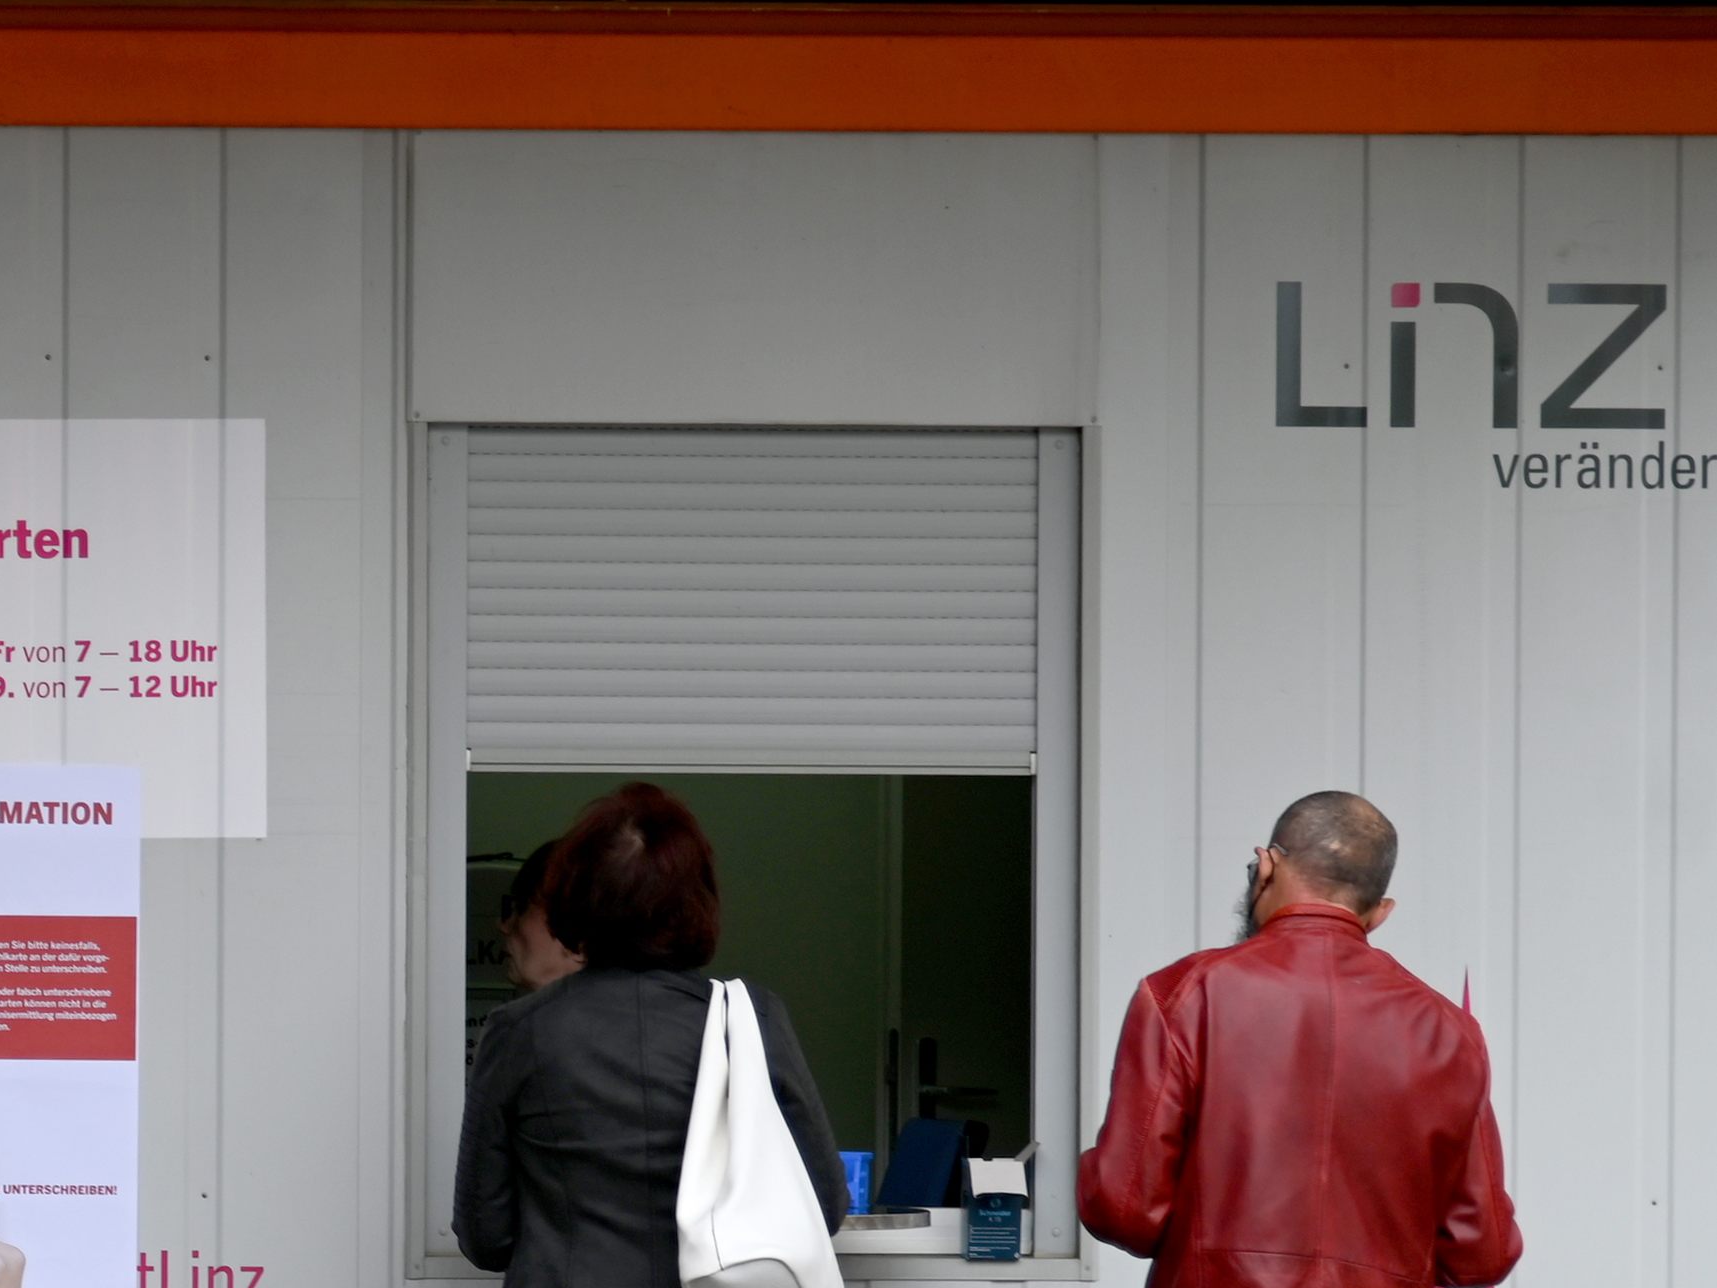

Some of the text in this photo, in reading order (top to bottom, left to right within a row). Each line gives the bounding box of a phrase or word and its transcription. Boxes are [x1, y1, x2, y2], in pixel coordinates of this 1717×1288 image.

[1276, 281, 1667, 429] Linz
[1493, 441, 1717, 489] veränder
[23, 645, 66, 663] von
[75, 640, 92, 662] 7
[130, 640, 162, 663] 18
[171, 640, 218, 663] Uhr
[23, 681, 66, 699] von
[75, 675, 92, 698] 7
[130, 675, 162, 699] 12
[171, 675, 218, 698] Uhr
[11, 941, 26, 949] Sie
[28, 941, 49, 949] bitte
[42, 953, 56, 961] der
[58, 1000, 80, 1008] nicht
[92, 1000, 106, 1008] die
[3, 1185, 118, 1196] UNTERSCHREIBEN!
